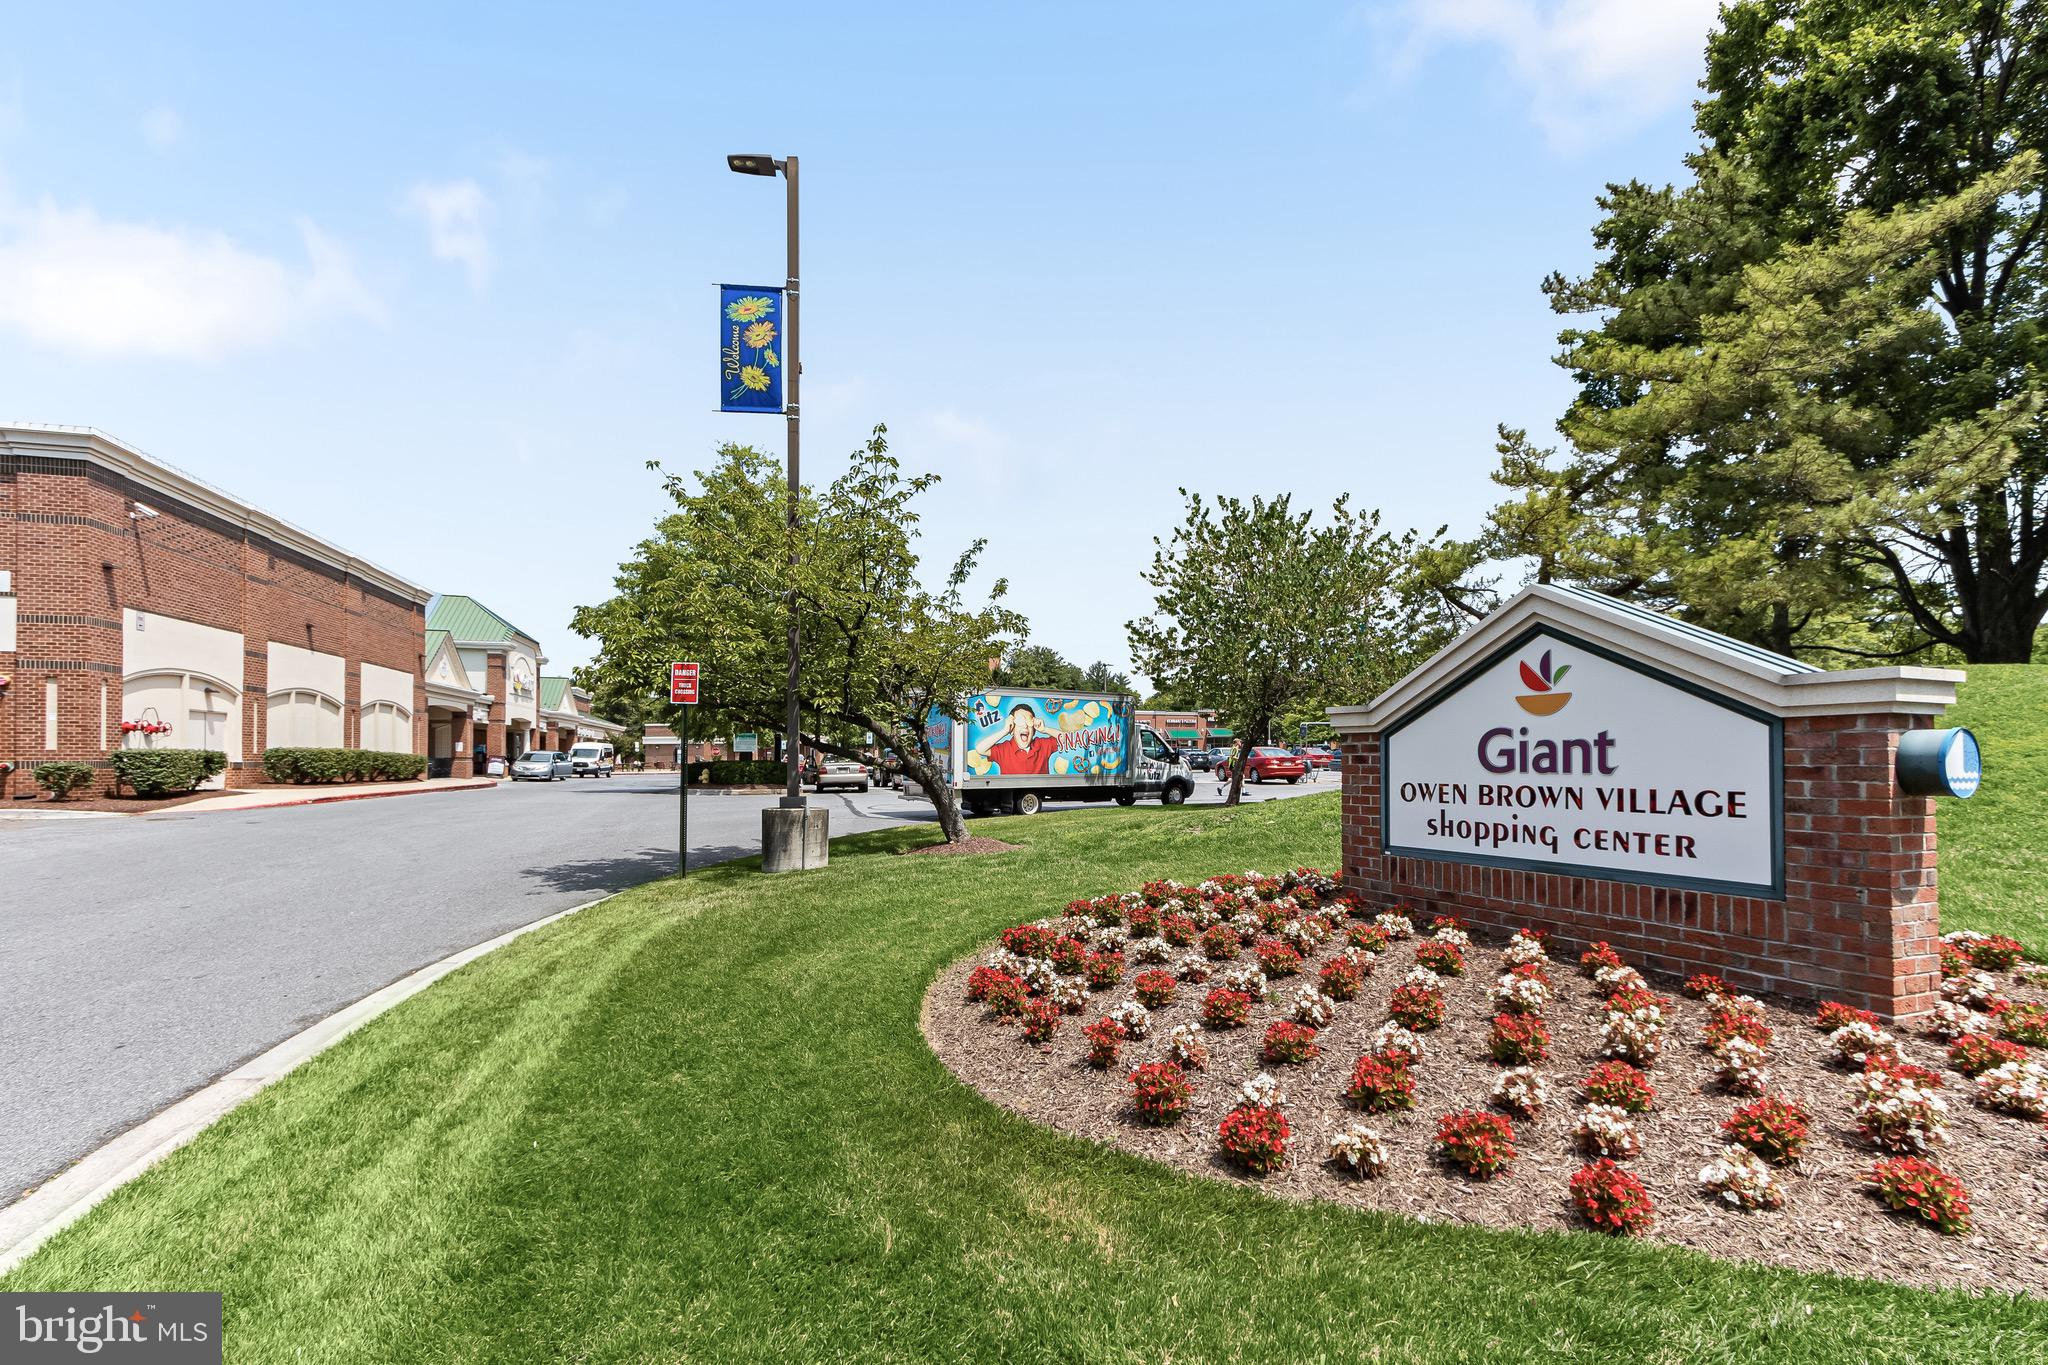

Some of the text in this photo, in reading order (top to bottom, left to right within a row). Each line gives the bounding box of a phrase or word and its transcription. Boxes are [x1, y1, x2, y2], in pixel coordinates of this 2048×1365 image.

[723, 325, 740, 381] Welcome
[1057, 723, 1120, 753] SNACKING!
[1477, 726, 1619, 775] Giant
[1400, 781, 1747, 819] OWEN BROWN VILLAGE
[1573, 827, 1698, 859] CENTER
